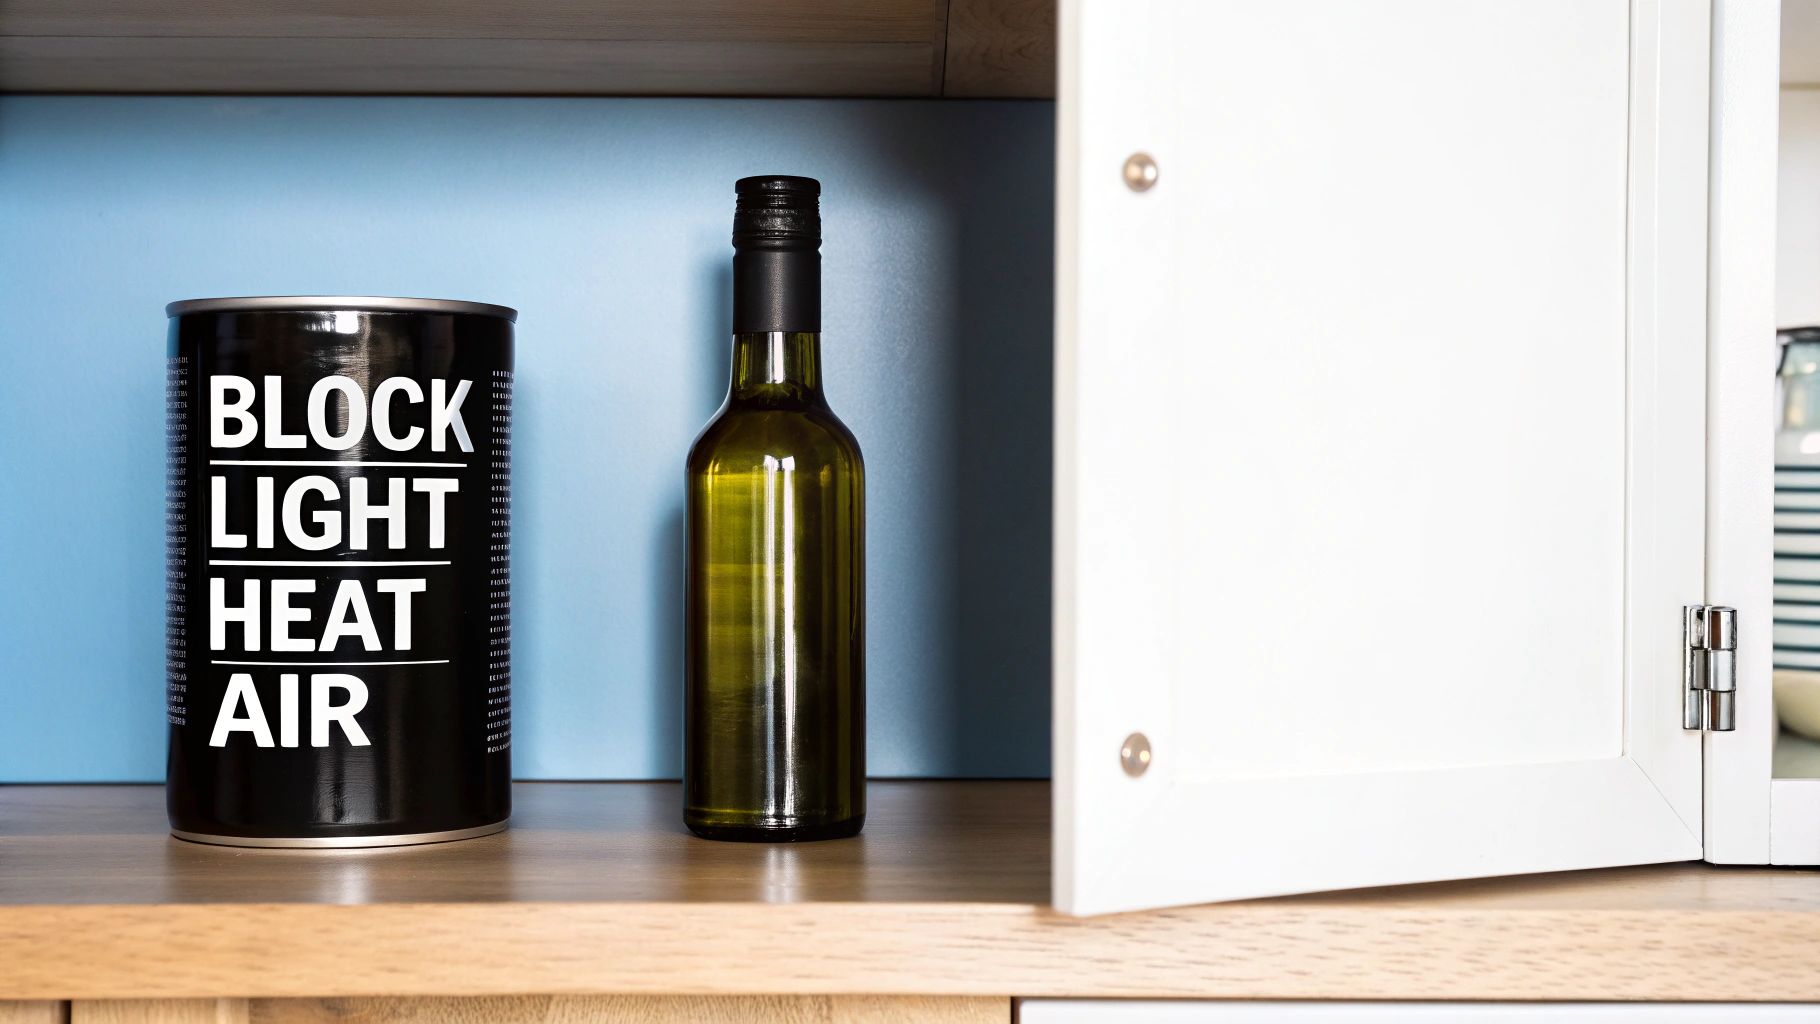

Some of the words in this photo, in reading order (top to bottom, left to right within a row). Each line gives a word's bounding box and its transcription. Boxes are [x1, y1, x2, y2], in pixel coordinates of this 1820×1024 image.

[210, 375, 475, 455] BLOCK
[210, 475, 459, 551] LIGHT
[209, 577, 427, 652] HEAT
[208, 673, 372, 748] AIR
